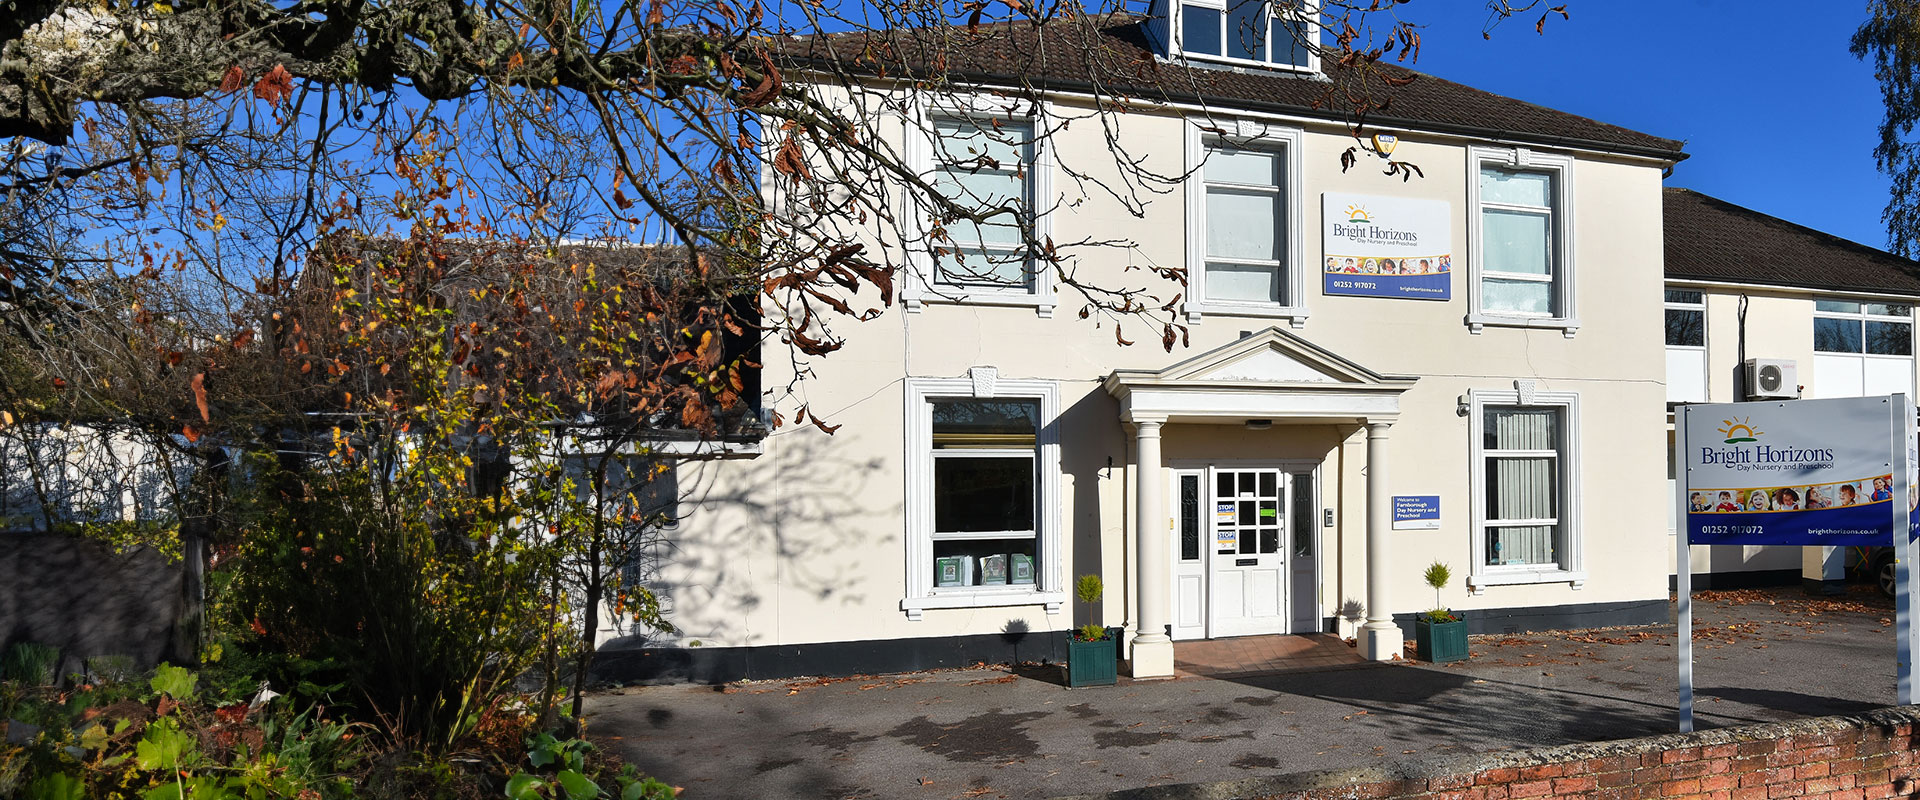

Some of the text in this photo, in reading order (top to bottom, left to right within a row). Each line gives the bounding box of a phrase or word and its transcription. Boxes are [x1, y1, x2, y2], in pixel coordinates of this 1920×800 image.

[1334, 224, 1418, 241] Bright Horizons
[1701, 445, 1834, 468] Bright Horizons
[1737, 464, 1750, 472] Day
[1752, 464, 1782, 472] Nursery
[1702, 526, 1764, 534] 01252 917072
